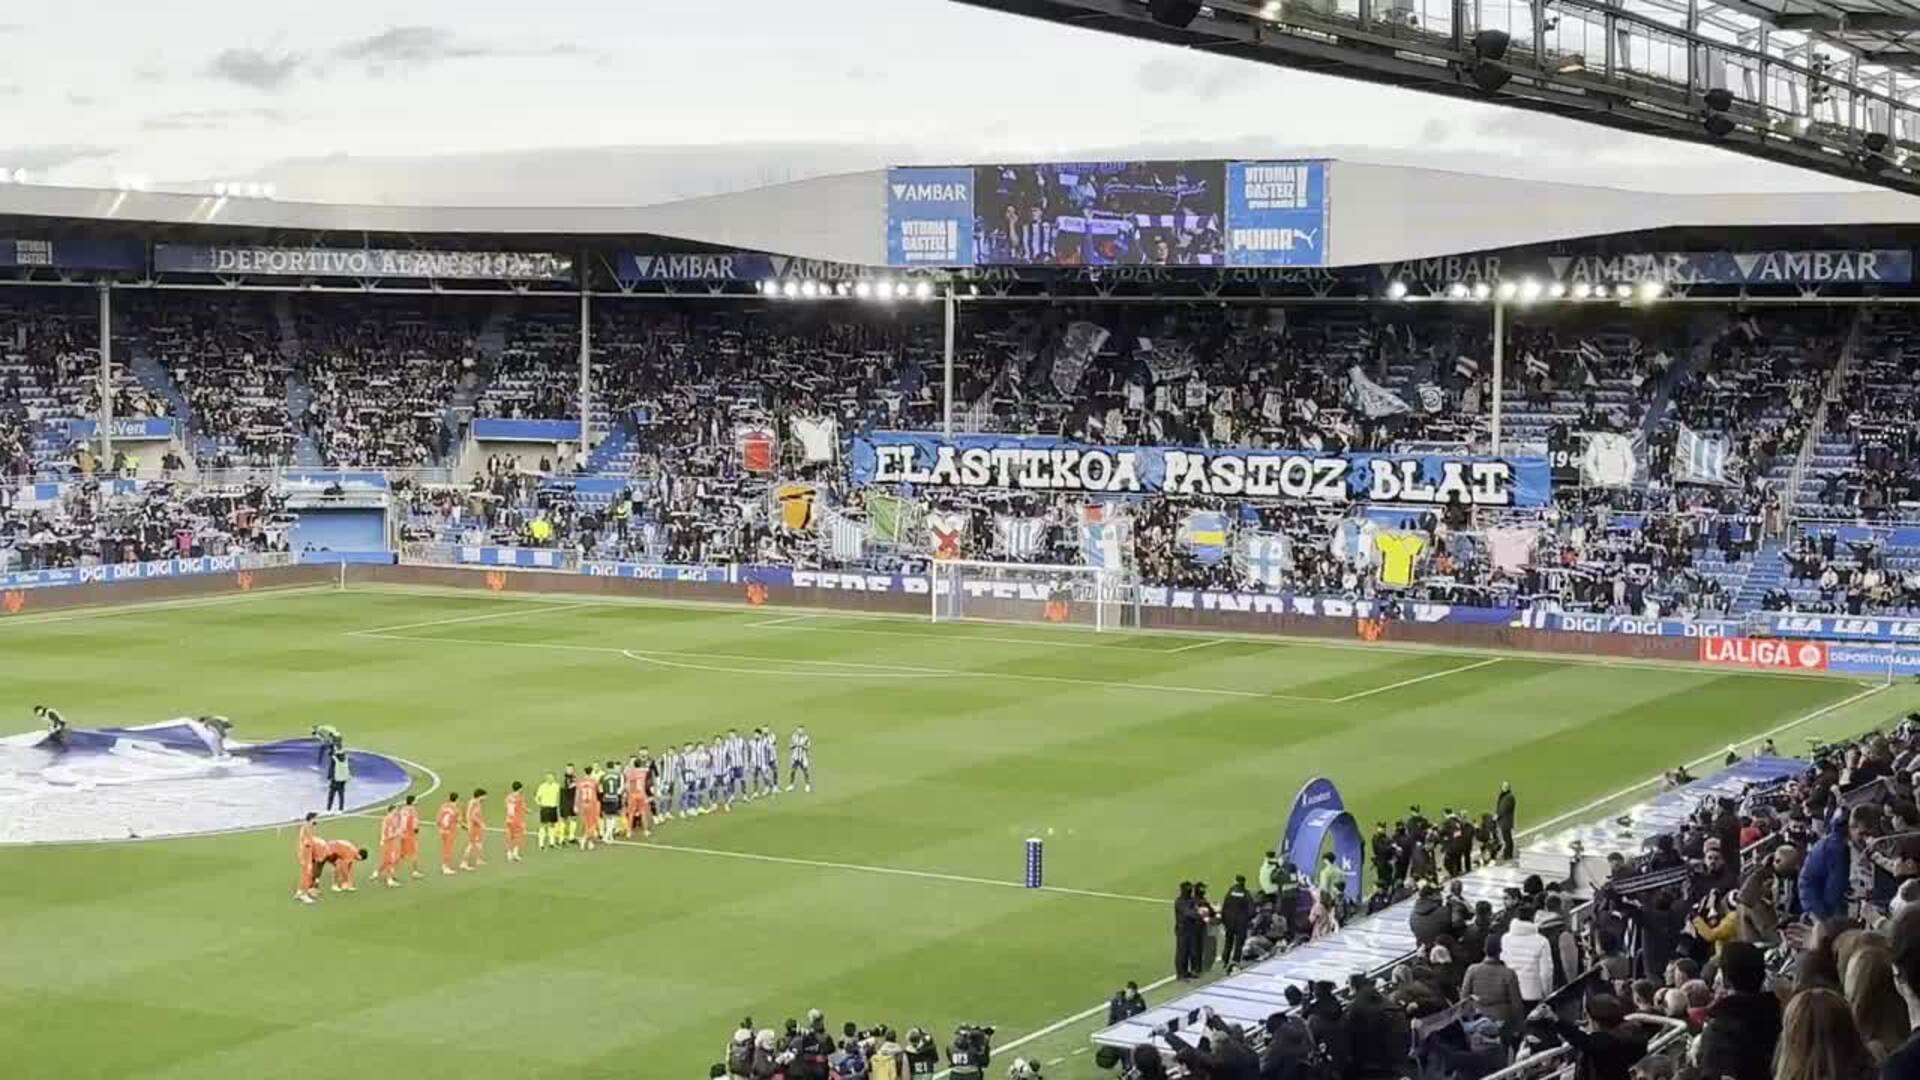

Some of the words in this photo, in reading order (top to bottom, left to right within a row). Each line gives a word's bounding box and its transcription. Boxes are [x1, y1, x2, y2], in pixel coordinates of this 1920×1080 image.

[1244, 166, 1295, 183] VITORIA
[905, 183, 966, 201] AMBAR
[1245, 183, 1295, 199] GASTEIZ
[1233, 229, 1295, 250] PUMA
[216, 250, 366, 273] DEPORTIVO
[651, 255, 736, 279] AMBAR
[1402, 257, 1500, 281] AMBAR
[1571, 254, 1683, 282] AMBAR
[1760, 252, 1881, 280] AMBAR
[875, 444, 1141, 491] ELASTIKOA
[1163, 451, 1349, 498] PASIOZ
[114, 563, 140, 578] DIGI
[147, 560, 173, 576] DIGI
[179, 558, 204, 574] DIGI
[211, 556, 236, 571] DIGI
[590, 565, 618, 577] DIGI
[633, 566, 662, 579] DIGI
[1562, 617, 1601, 632] DIGI
[1622, 620, 1662, 635] DIGI
[1684, 622, 1724, 637] DIGI
[1777, 617, 1823, 631] LEA
[1833, 618, 1879, 635] LEA
[1705, 639, 1791, 665] LALIGA
